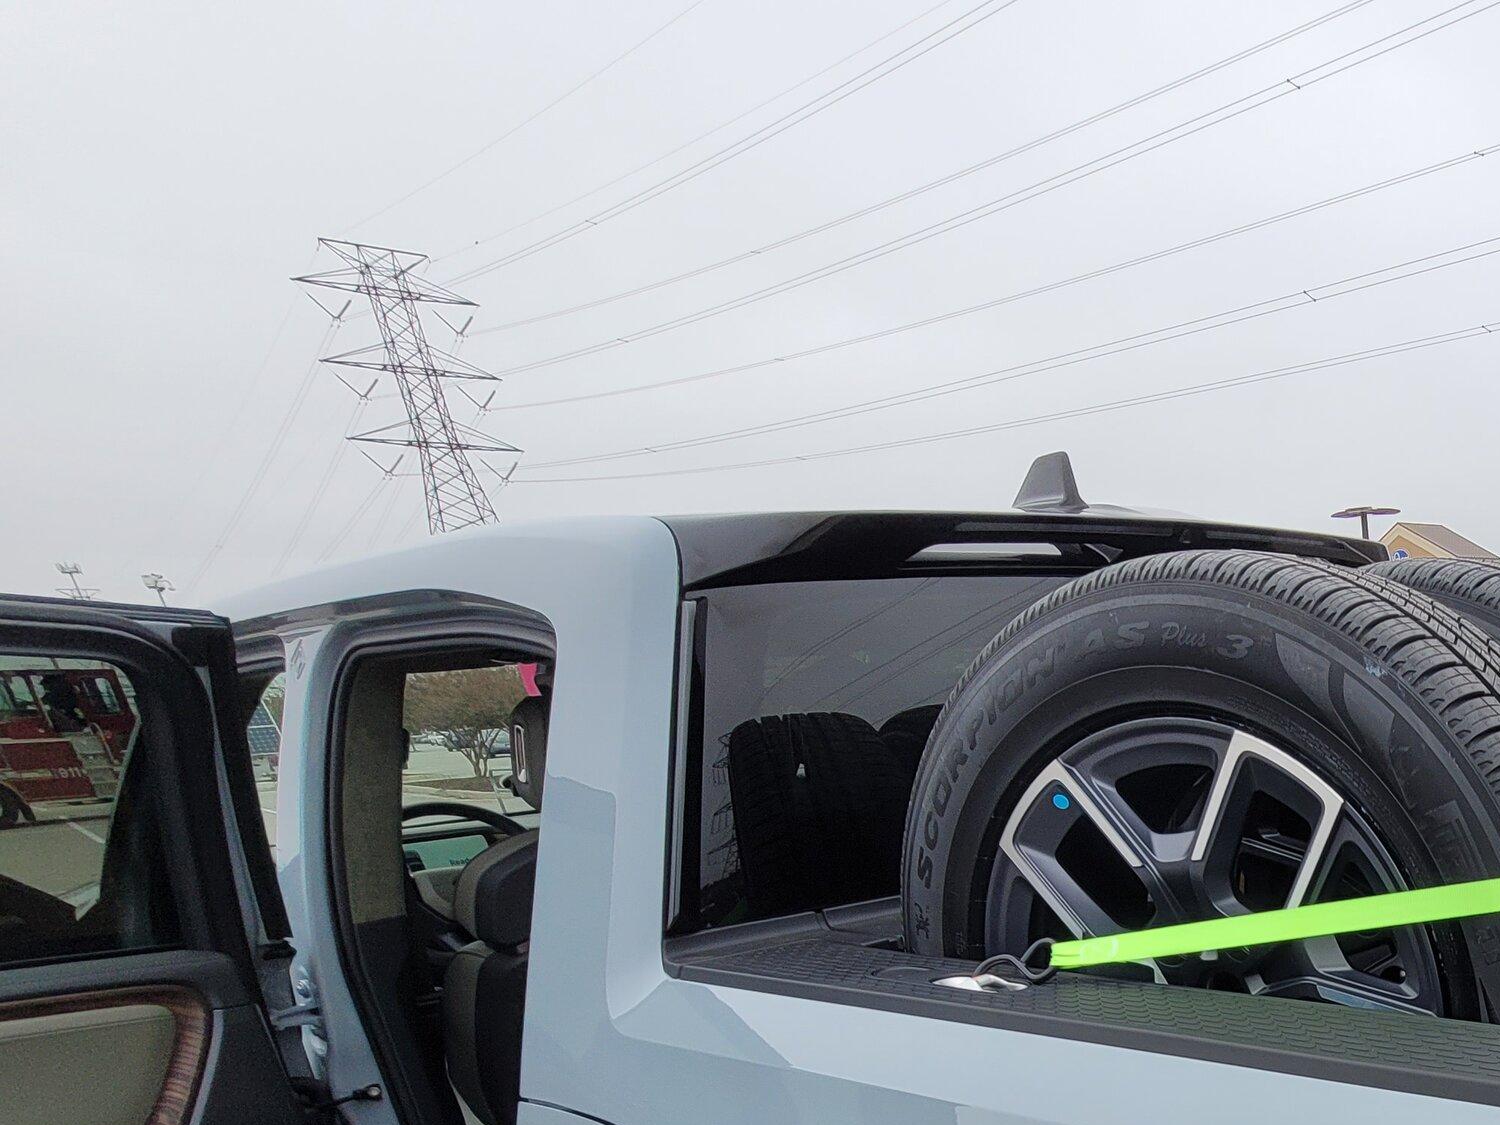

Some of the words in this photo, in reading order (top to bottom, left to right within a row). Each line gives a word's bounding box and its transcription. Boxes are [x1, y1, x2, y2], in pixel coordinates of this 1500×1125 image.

[916, 651, 1058, 889] SCORPION
[1159, 621, 1208, 650] Plus
[1216, 634, 1255, 659] 3
